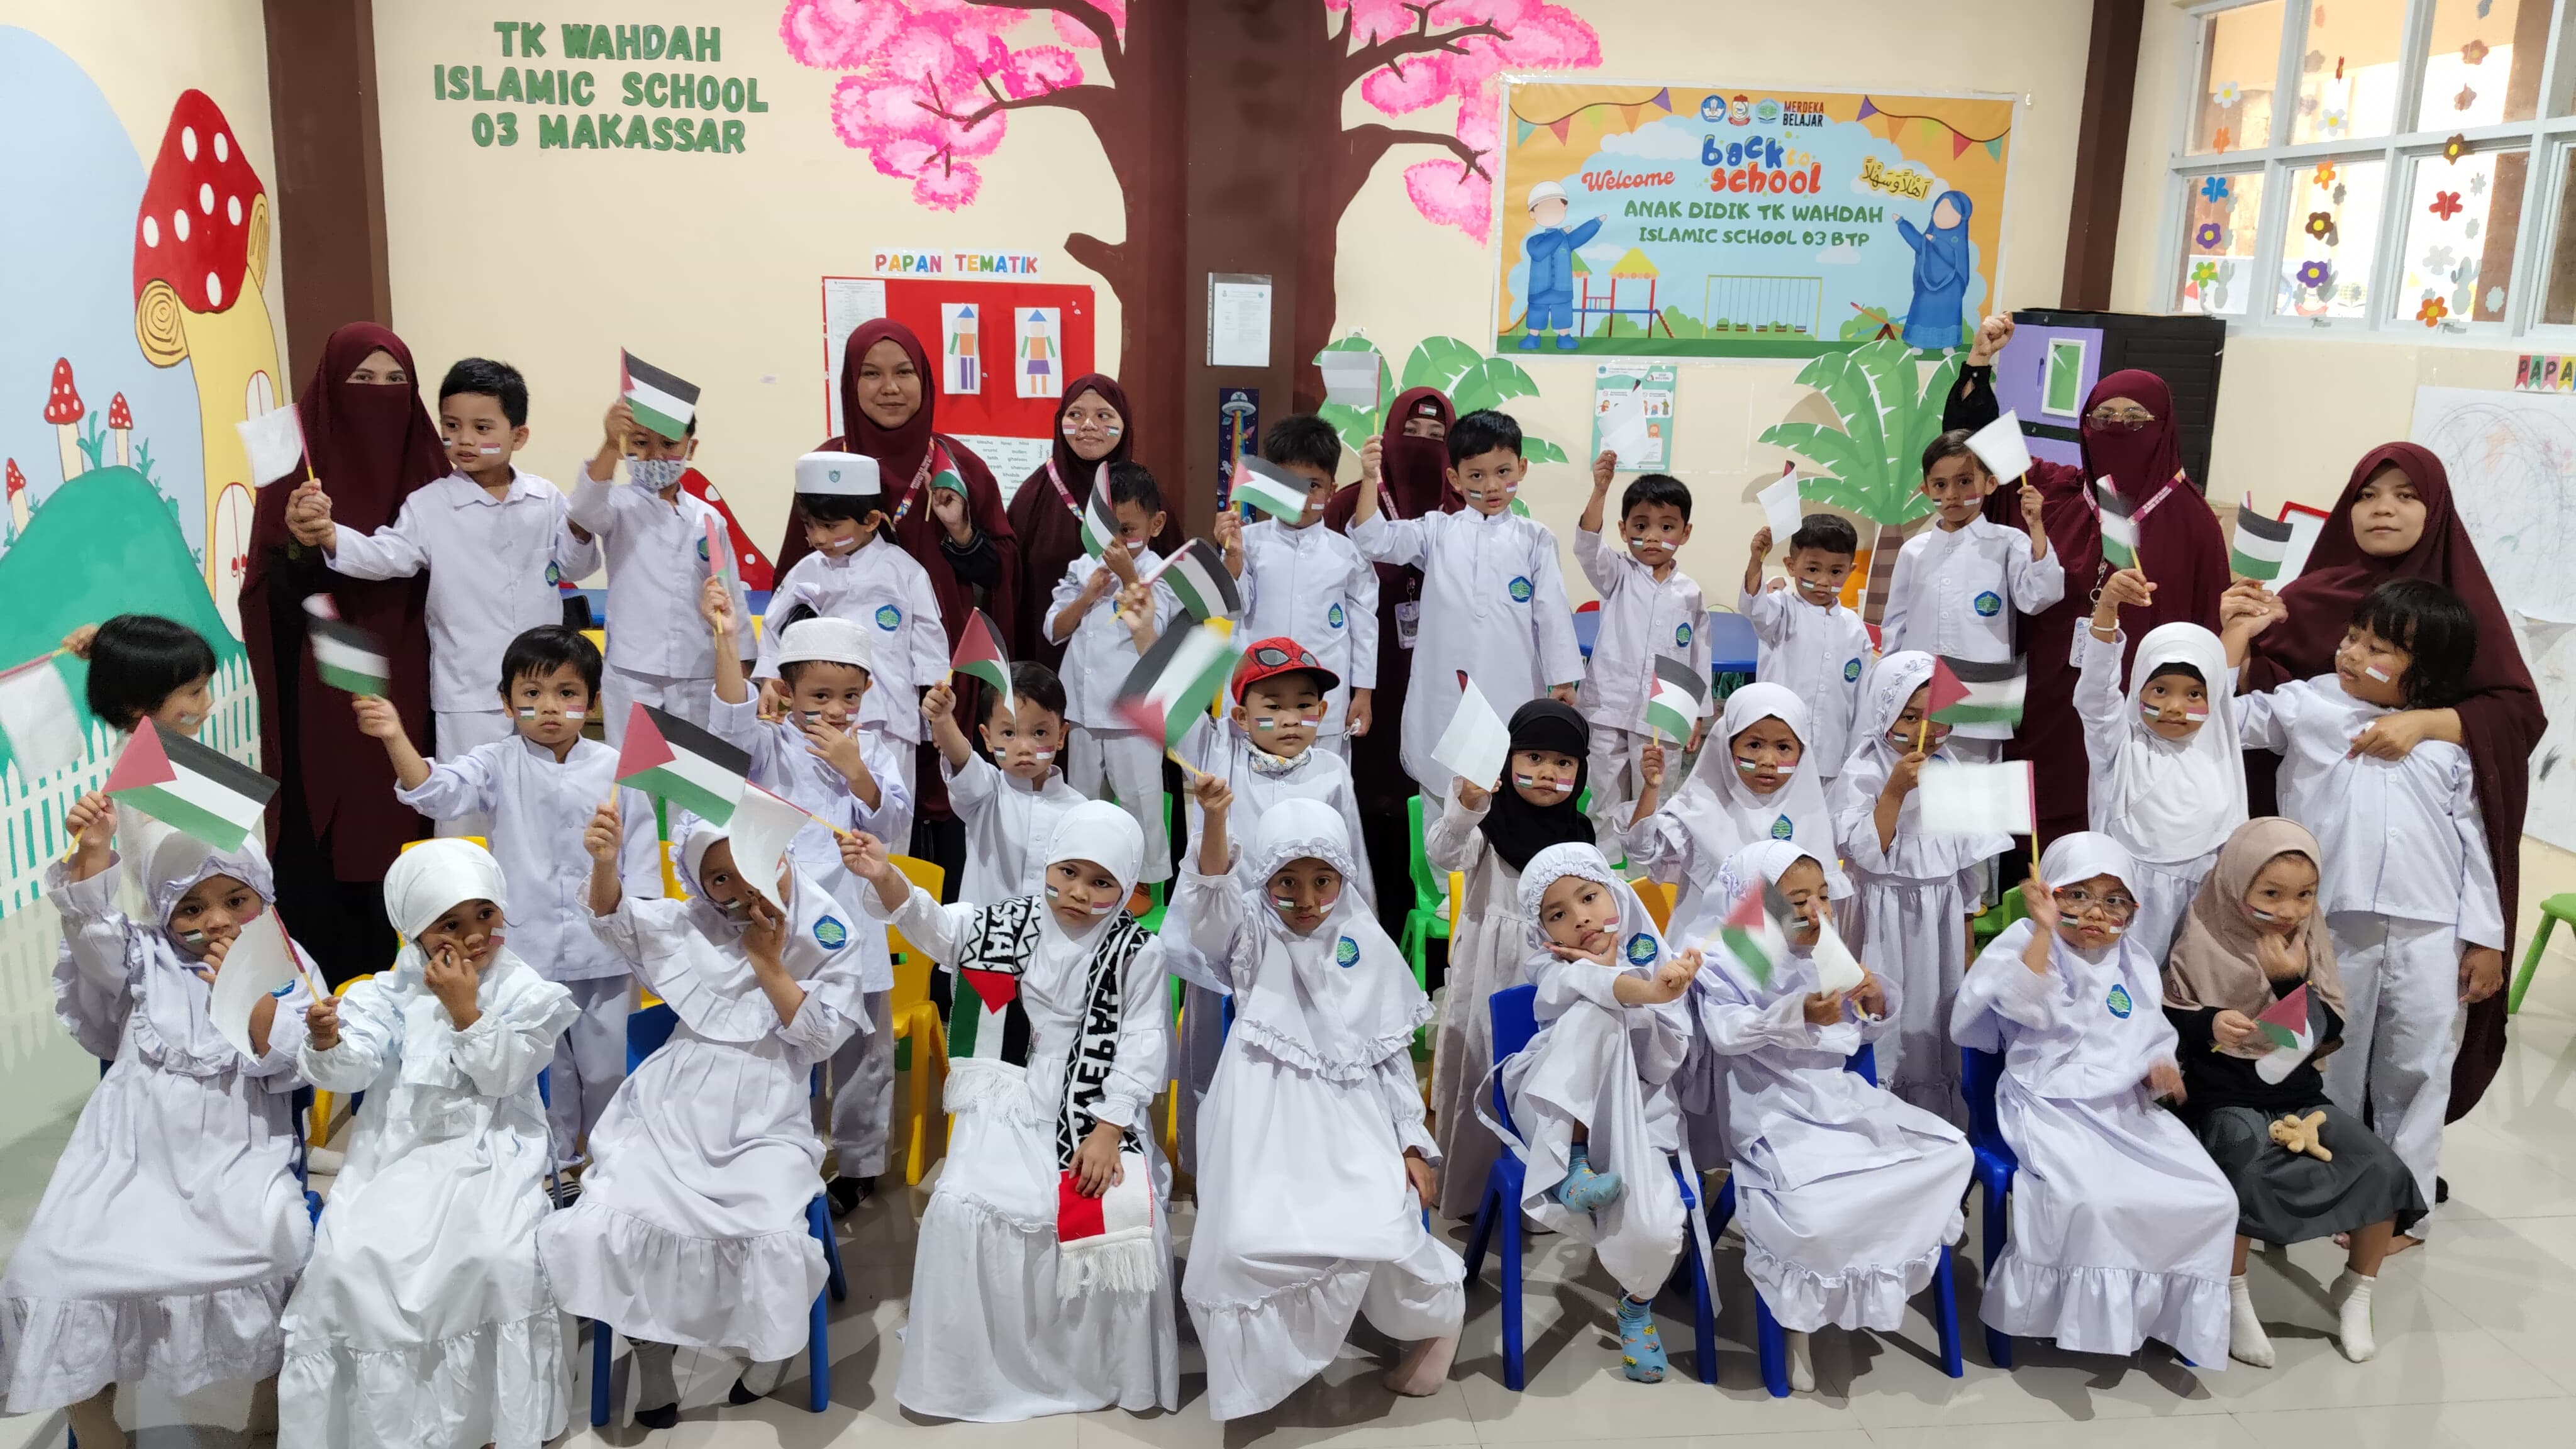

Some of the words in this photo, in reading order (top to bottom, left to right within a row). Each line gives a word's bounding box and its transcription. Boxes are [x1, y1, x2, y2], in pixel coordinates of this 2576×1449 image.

[494, 21, 546, 57] TK
[561, 23, 721, 62] WAHDAH
[434, 64, 595, 106] ISLAMIC
[621, 72, 769, 113] SCHOOL
[1784, 101, 1824, 114] MERDEKA
[1782, 113, 1824, 127] BELAJAR
[472, 112, 518, 147] 03
[539, 113, 746, 153] MAKASSAR
[1581, 169, 1675, 192] Welcome
[1710, 161, 1821, 194] school
[1624, 199, 1682, 218] ANAK
[1689, 202, 1750, 219] DIDIK
[1757, 203, 1785, 221] TK
[1792, 205, 1884, 223] WAHDAH
[1639, 226, 1718, 243] ISLAMIC
[1722, 229, 1797, 246] SCHOOL
[1802, 231, 1827, 247] 03
[1831, 231, 1870, 247] BTP
[875, 254, 942, 273] PAPAN
[955, 253, 1038, 274] TEMATIK
[2518, 359, 2573, 382] PAPA
